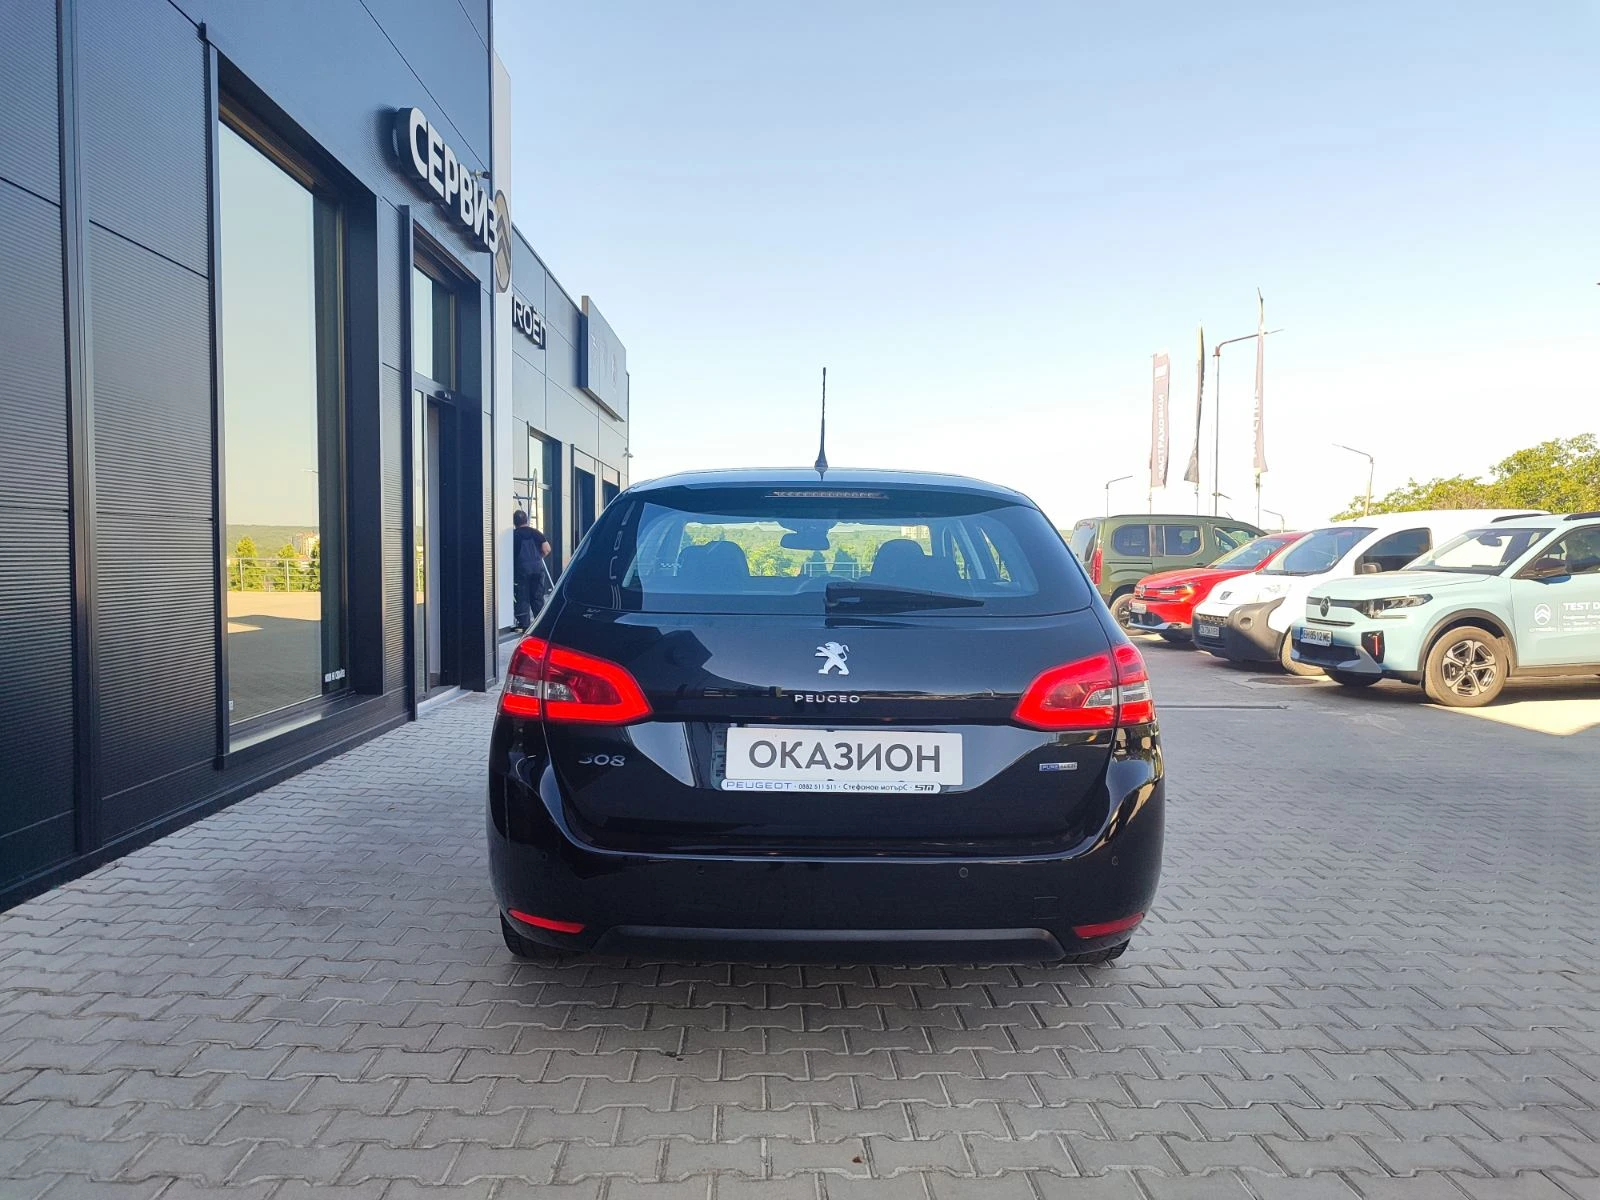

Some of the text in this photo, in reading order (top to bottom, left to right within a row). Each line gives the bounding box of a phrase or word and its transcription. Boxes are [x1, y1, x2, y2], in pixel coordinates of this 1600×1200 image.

[409, 107, 498, 254] СЕРВИЗ
[1562, 601, 1591, 611] TEST
[748, 739, 941, 773] ОКАЗИОН
[725, 781, 793, 790] PEUGEOT
